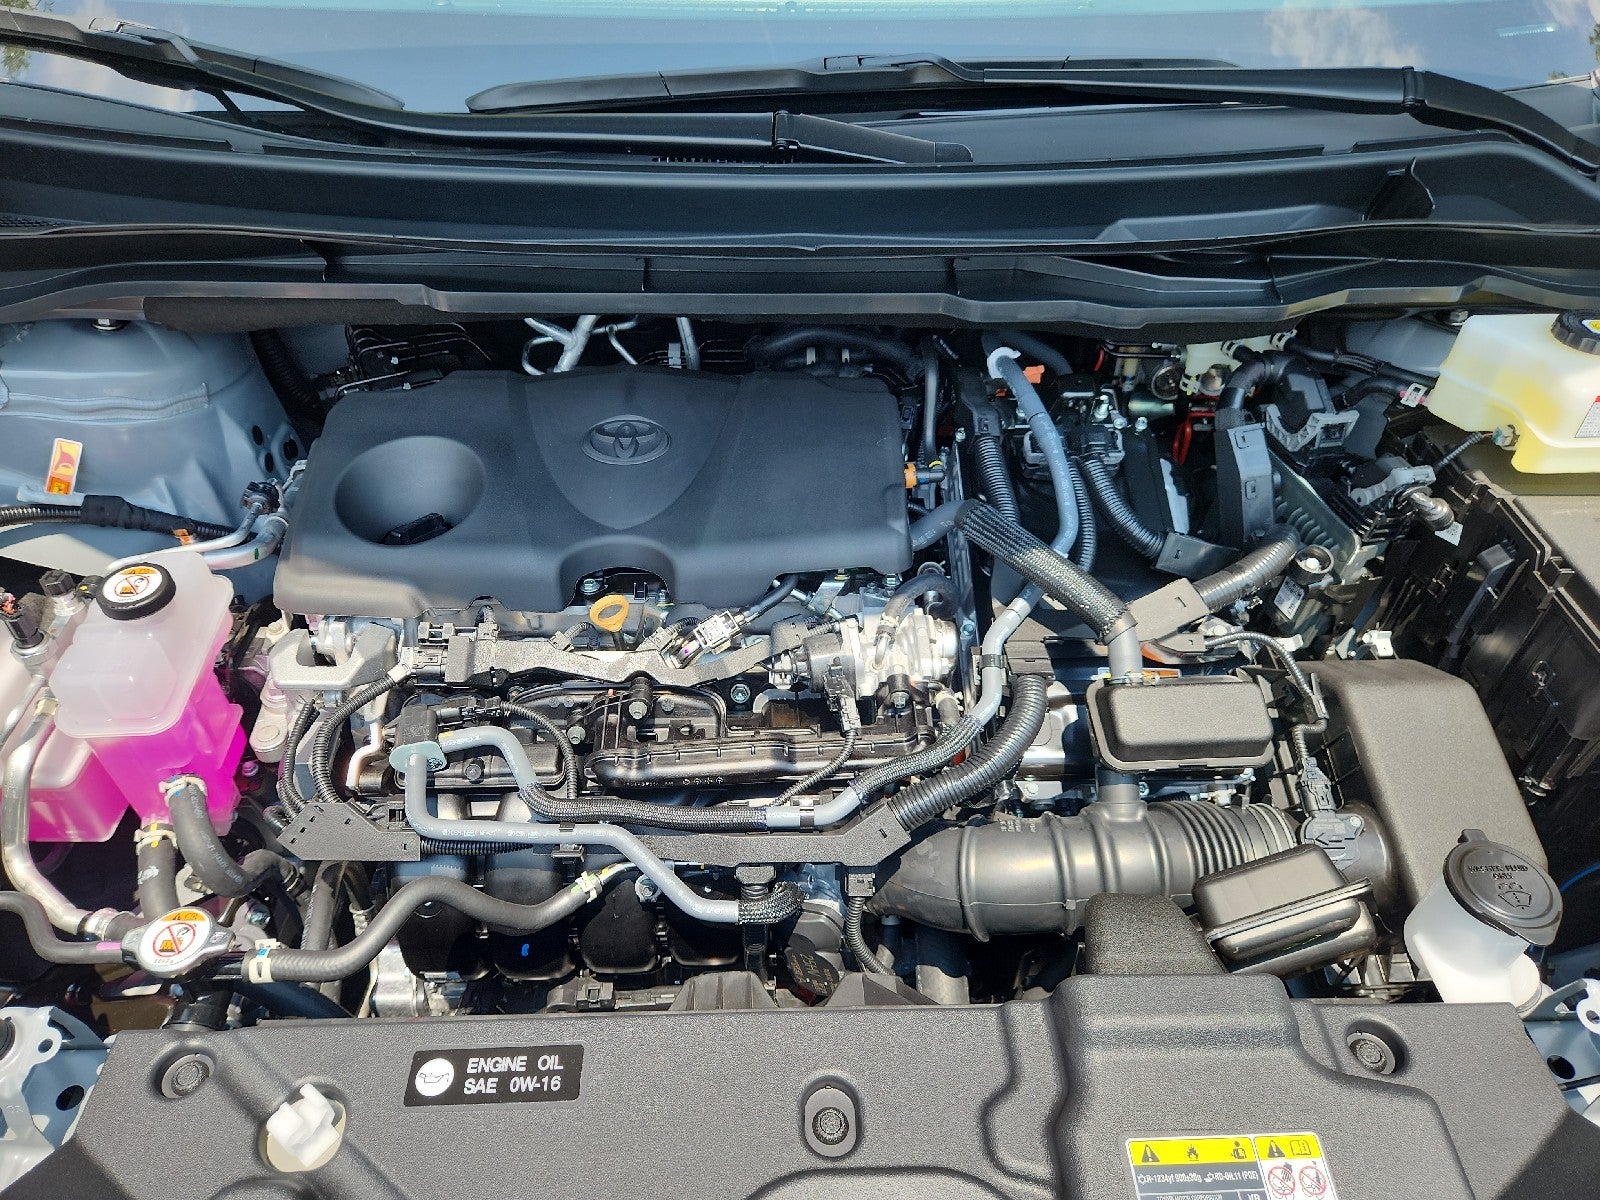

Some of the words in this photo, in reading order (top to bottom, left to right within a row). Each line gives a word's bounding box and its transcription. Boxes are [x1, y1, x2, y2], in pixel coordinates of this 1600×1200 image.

[466, 1056, 527, 1074] ENGINE
[537, 1055, 564, 1071] OIL
[463, 1078, 498, 1095] SAE
[509, 1076, 562, 1093] 0W-16
